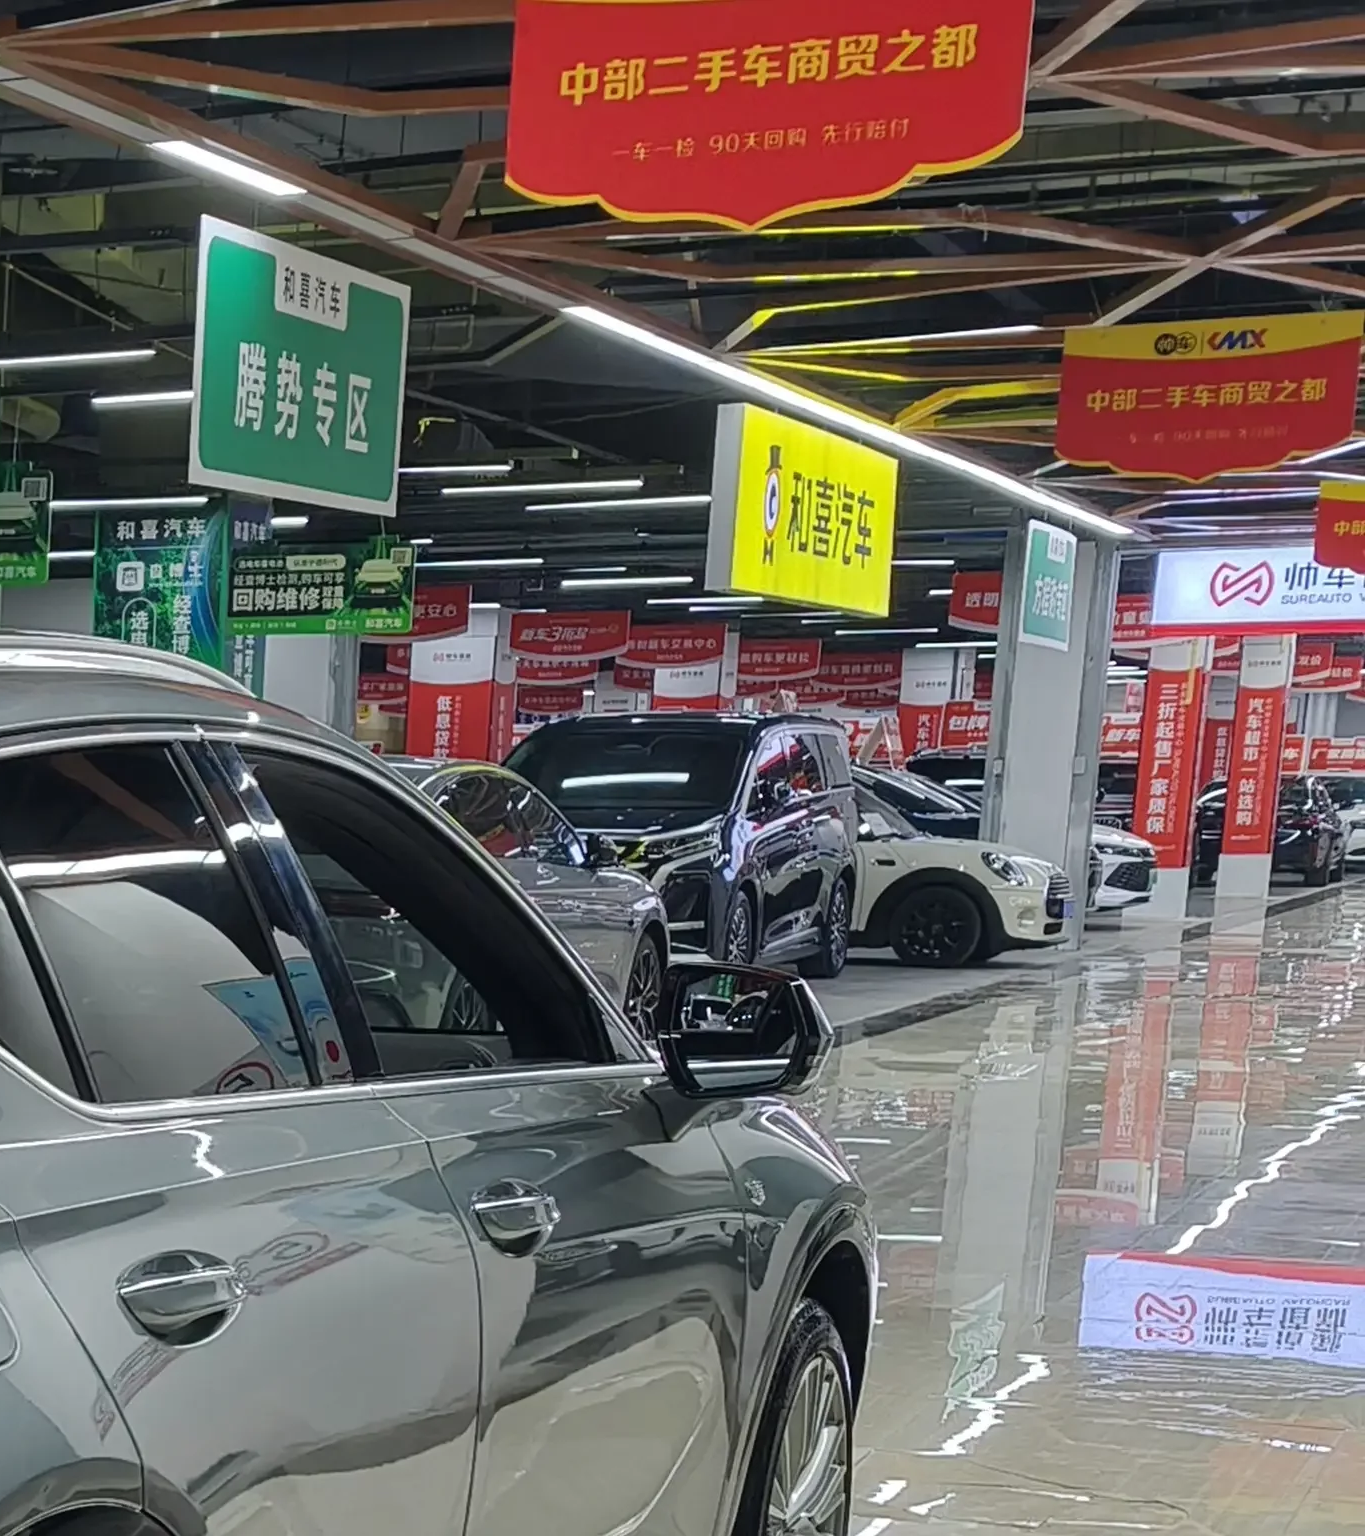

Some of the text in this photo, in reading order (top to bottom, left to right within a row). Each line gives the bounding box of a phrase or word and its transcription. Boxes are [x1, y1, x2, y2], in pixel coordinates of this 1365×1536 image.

[559, 23, 978, 106] 中部二手车商贸之都
[612, 117, 911, 161] 一车一检 90天回购 先行赔付
[282, 265, 341, 319] 和喜汽车
[234, 341, 372, 453] 腾势专区
[1086, 377, 1328, 413] 中部二手车商贸之都
[117, 516, 207, 541] 和喜汽车
[787, 470, 875, 570] 和喜汽车
[1284, 562, 1365, 591] 帅车
[232, 587, 321, 612] 回购维修
[965, 591, 1000, 608] 透明
[1281, 592, 1353, 606] SUREAUTO
[130, 610, 149, 646] 选电
[172, 594, 192, 655] 经查博
[1146, 683, 1179, 834] 三折起售厂家质保
[1236, 697, 1265, 826] 汽车超市一站选购
